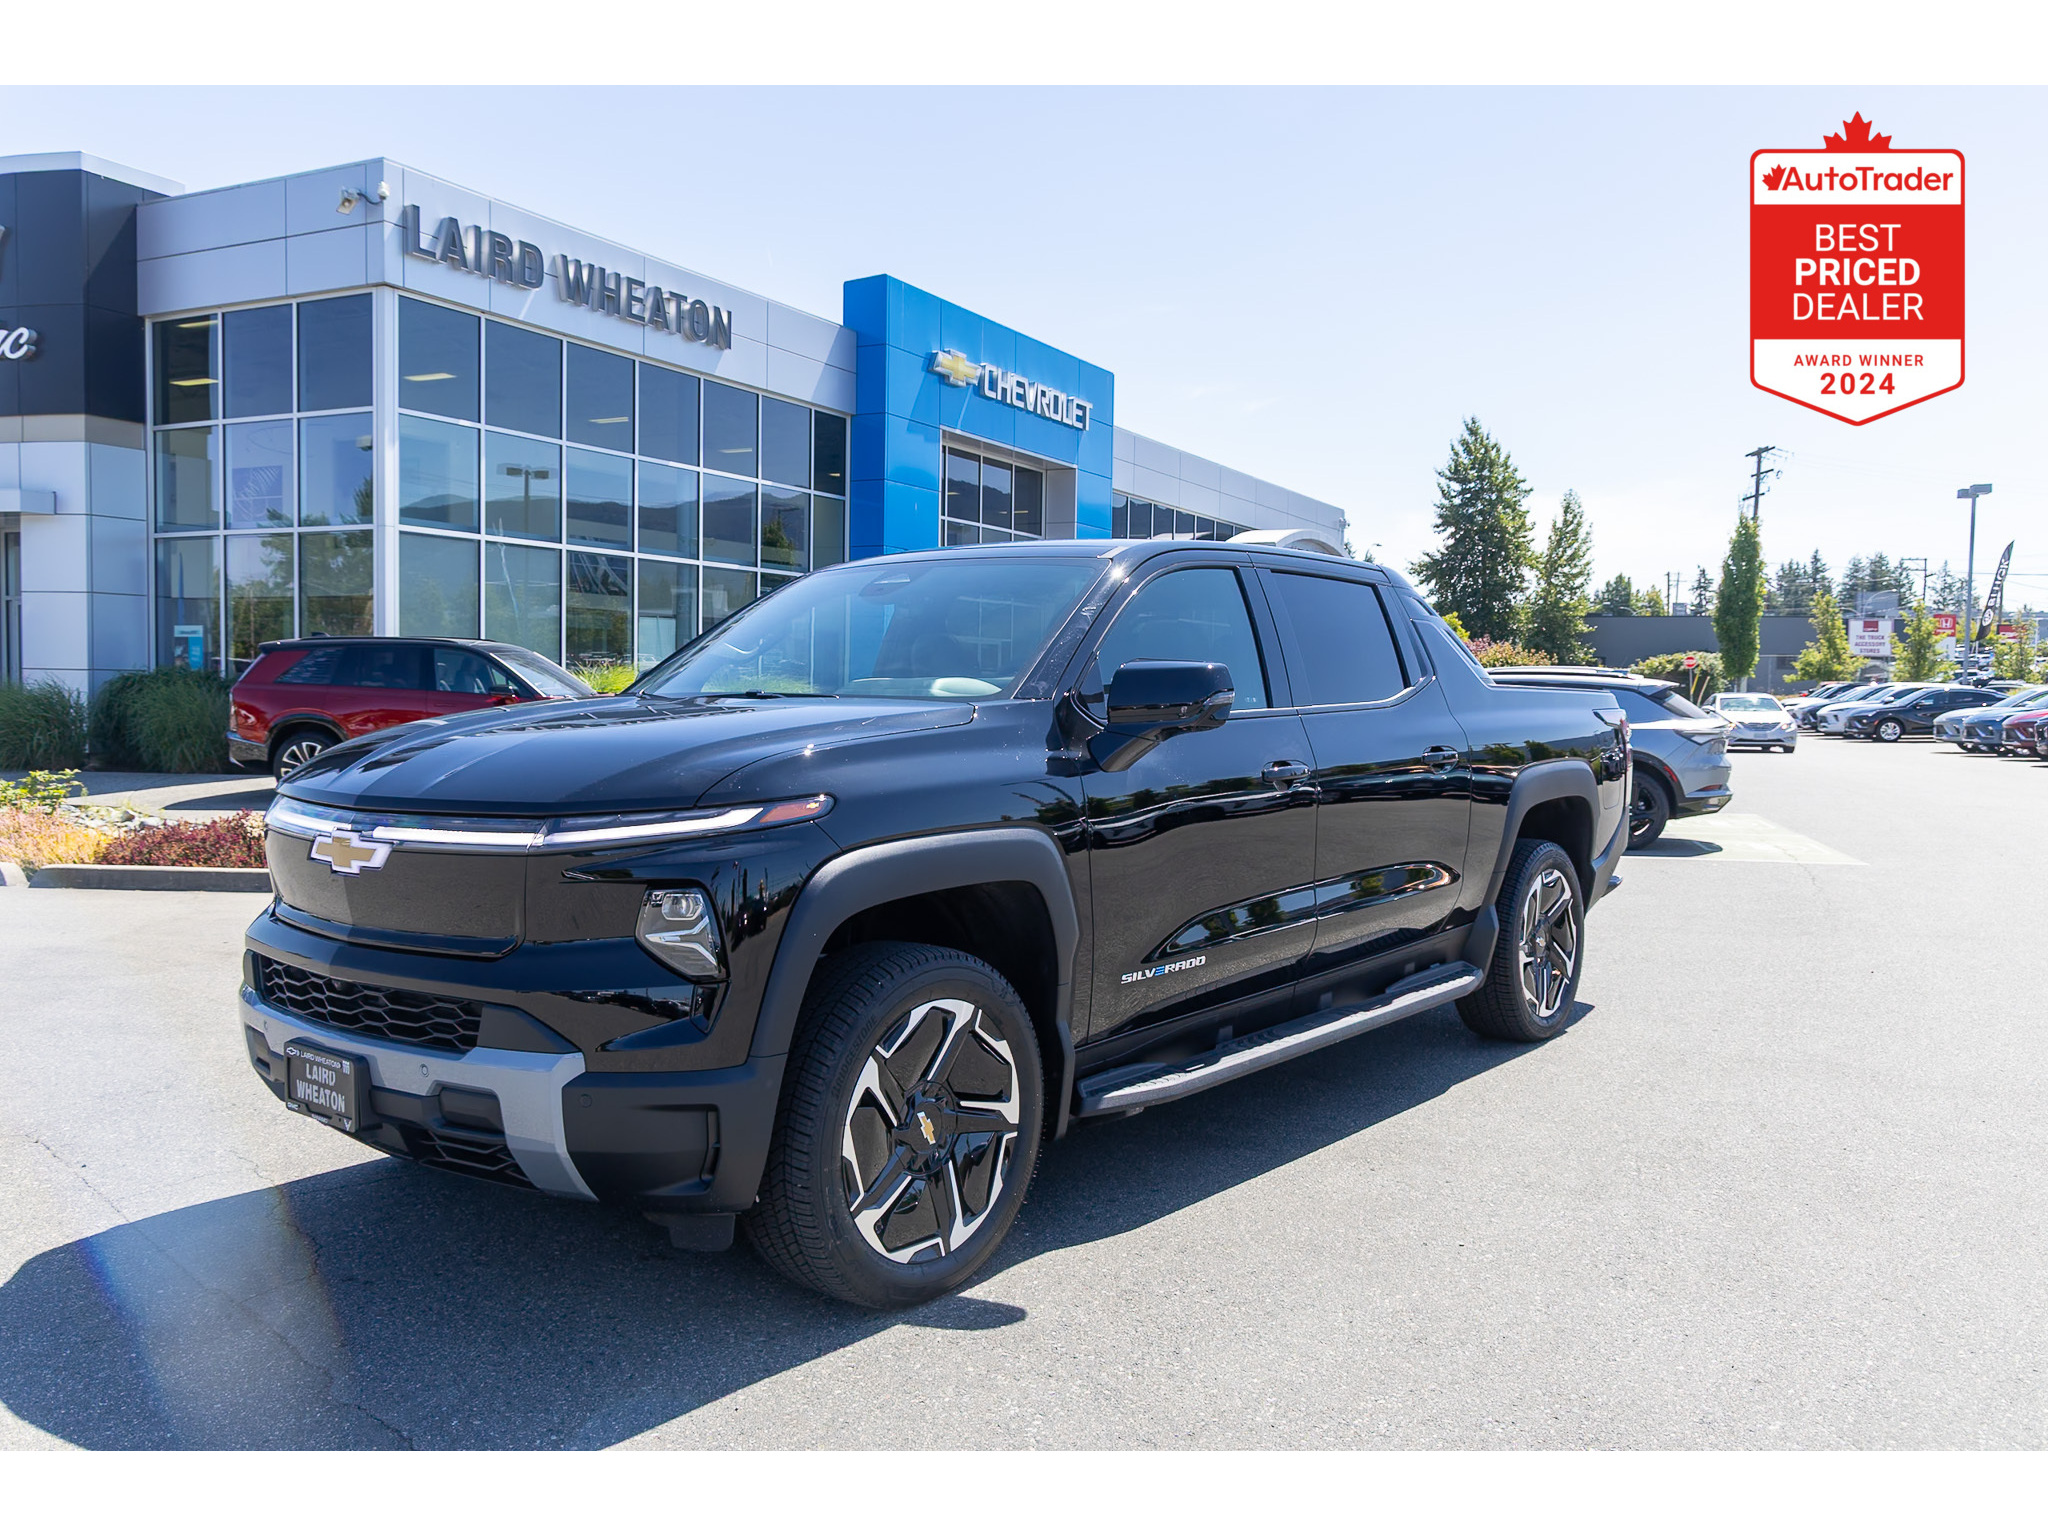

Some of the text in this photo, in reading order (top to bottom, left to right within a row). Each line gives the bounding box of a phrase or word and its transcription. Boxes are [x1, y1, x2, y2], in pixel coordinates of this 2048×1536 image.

[403, 203, 732, 350] LAIRD WHEATON
[980, 362, 1094, 431] CHEVROLET
[1987, 558, 2009, 607] BUICK
[1120, 955, 1207, 984] SILVERADO
[305, 1062, 336, 1087] LAIRD
[296, 1079, 345, 1113] WHEATON
